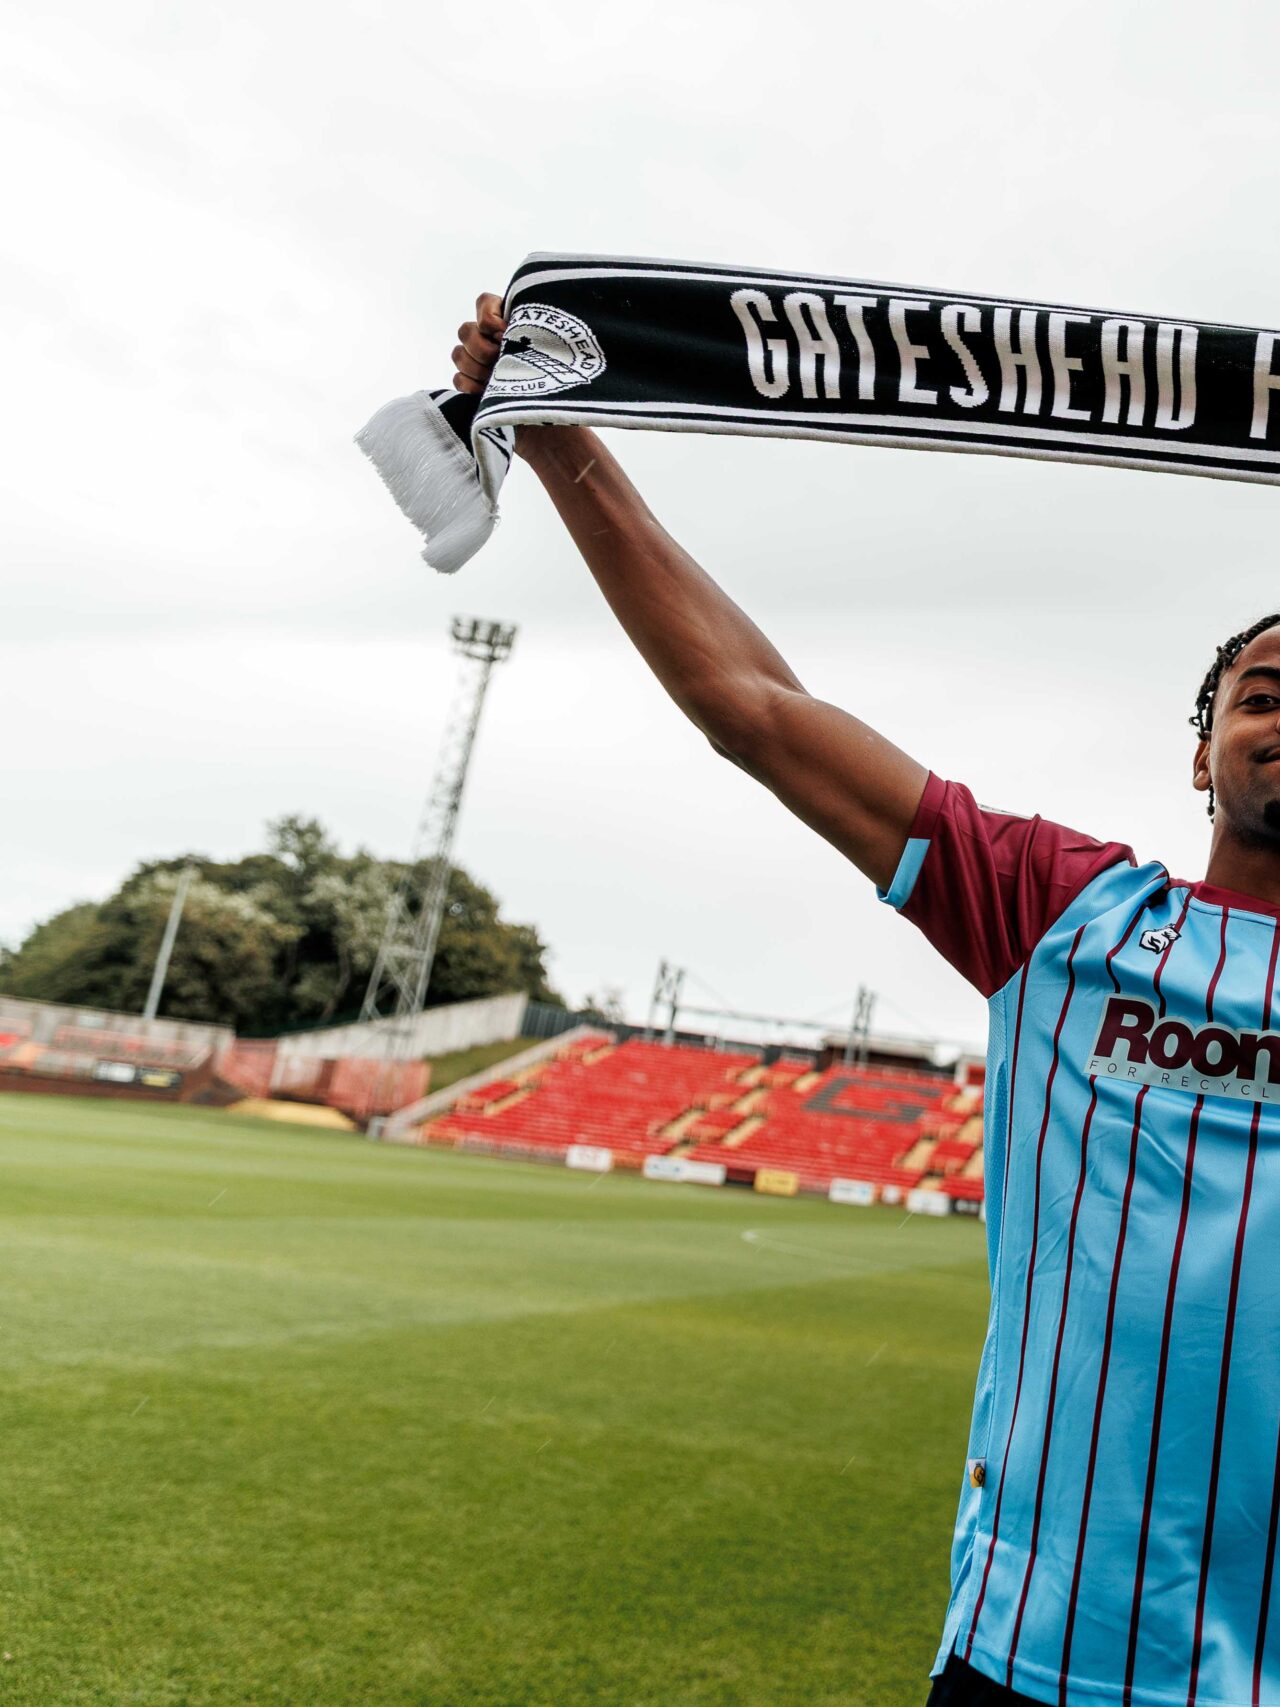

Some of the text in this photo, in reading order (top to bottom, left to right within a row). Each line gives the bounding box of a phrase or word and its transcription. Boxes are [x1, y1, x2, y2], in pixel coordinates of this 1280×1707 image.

[729, 288, 1199, 431] GATESHEAD
[511, 381, 546, 391] CLUB
[1089, 1060, 1137, 1077] FOR
